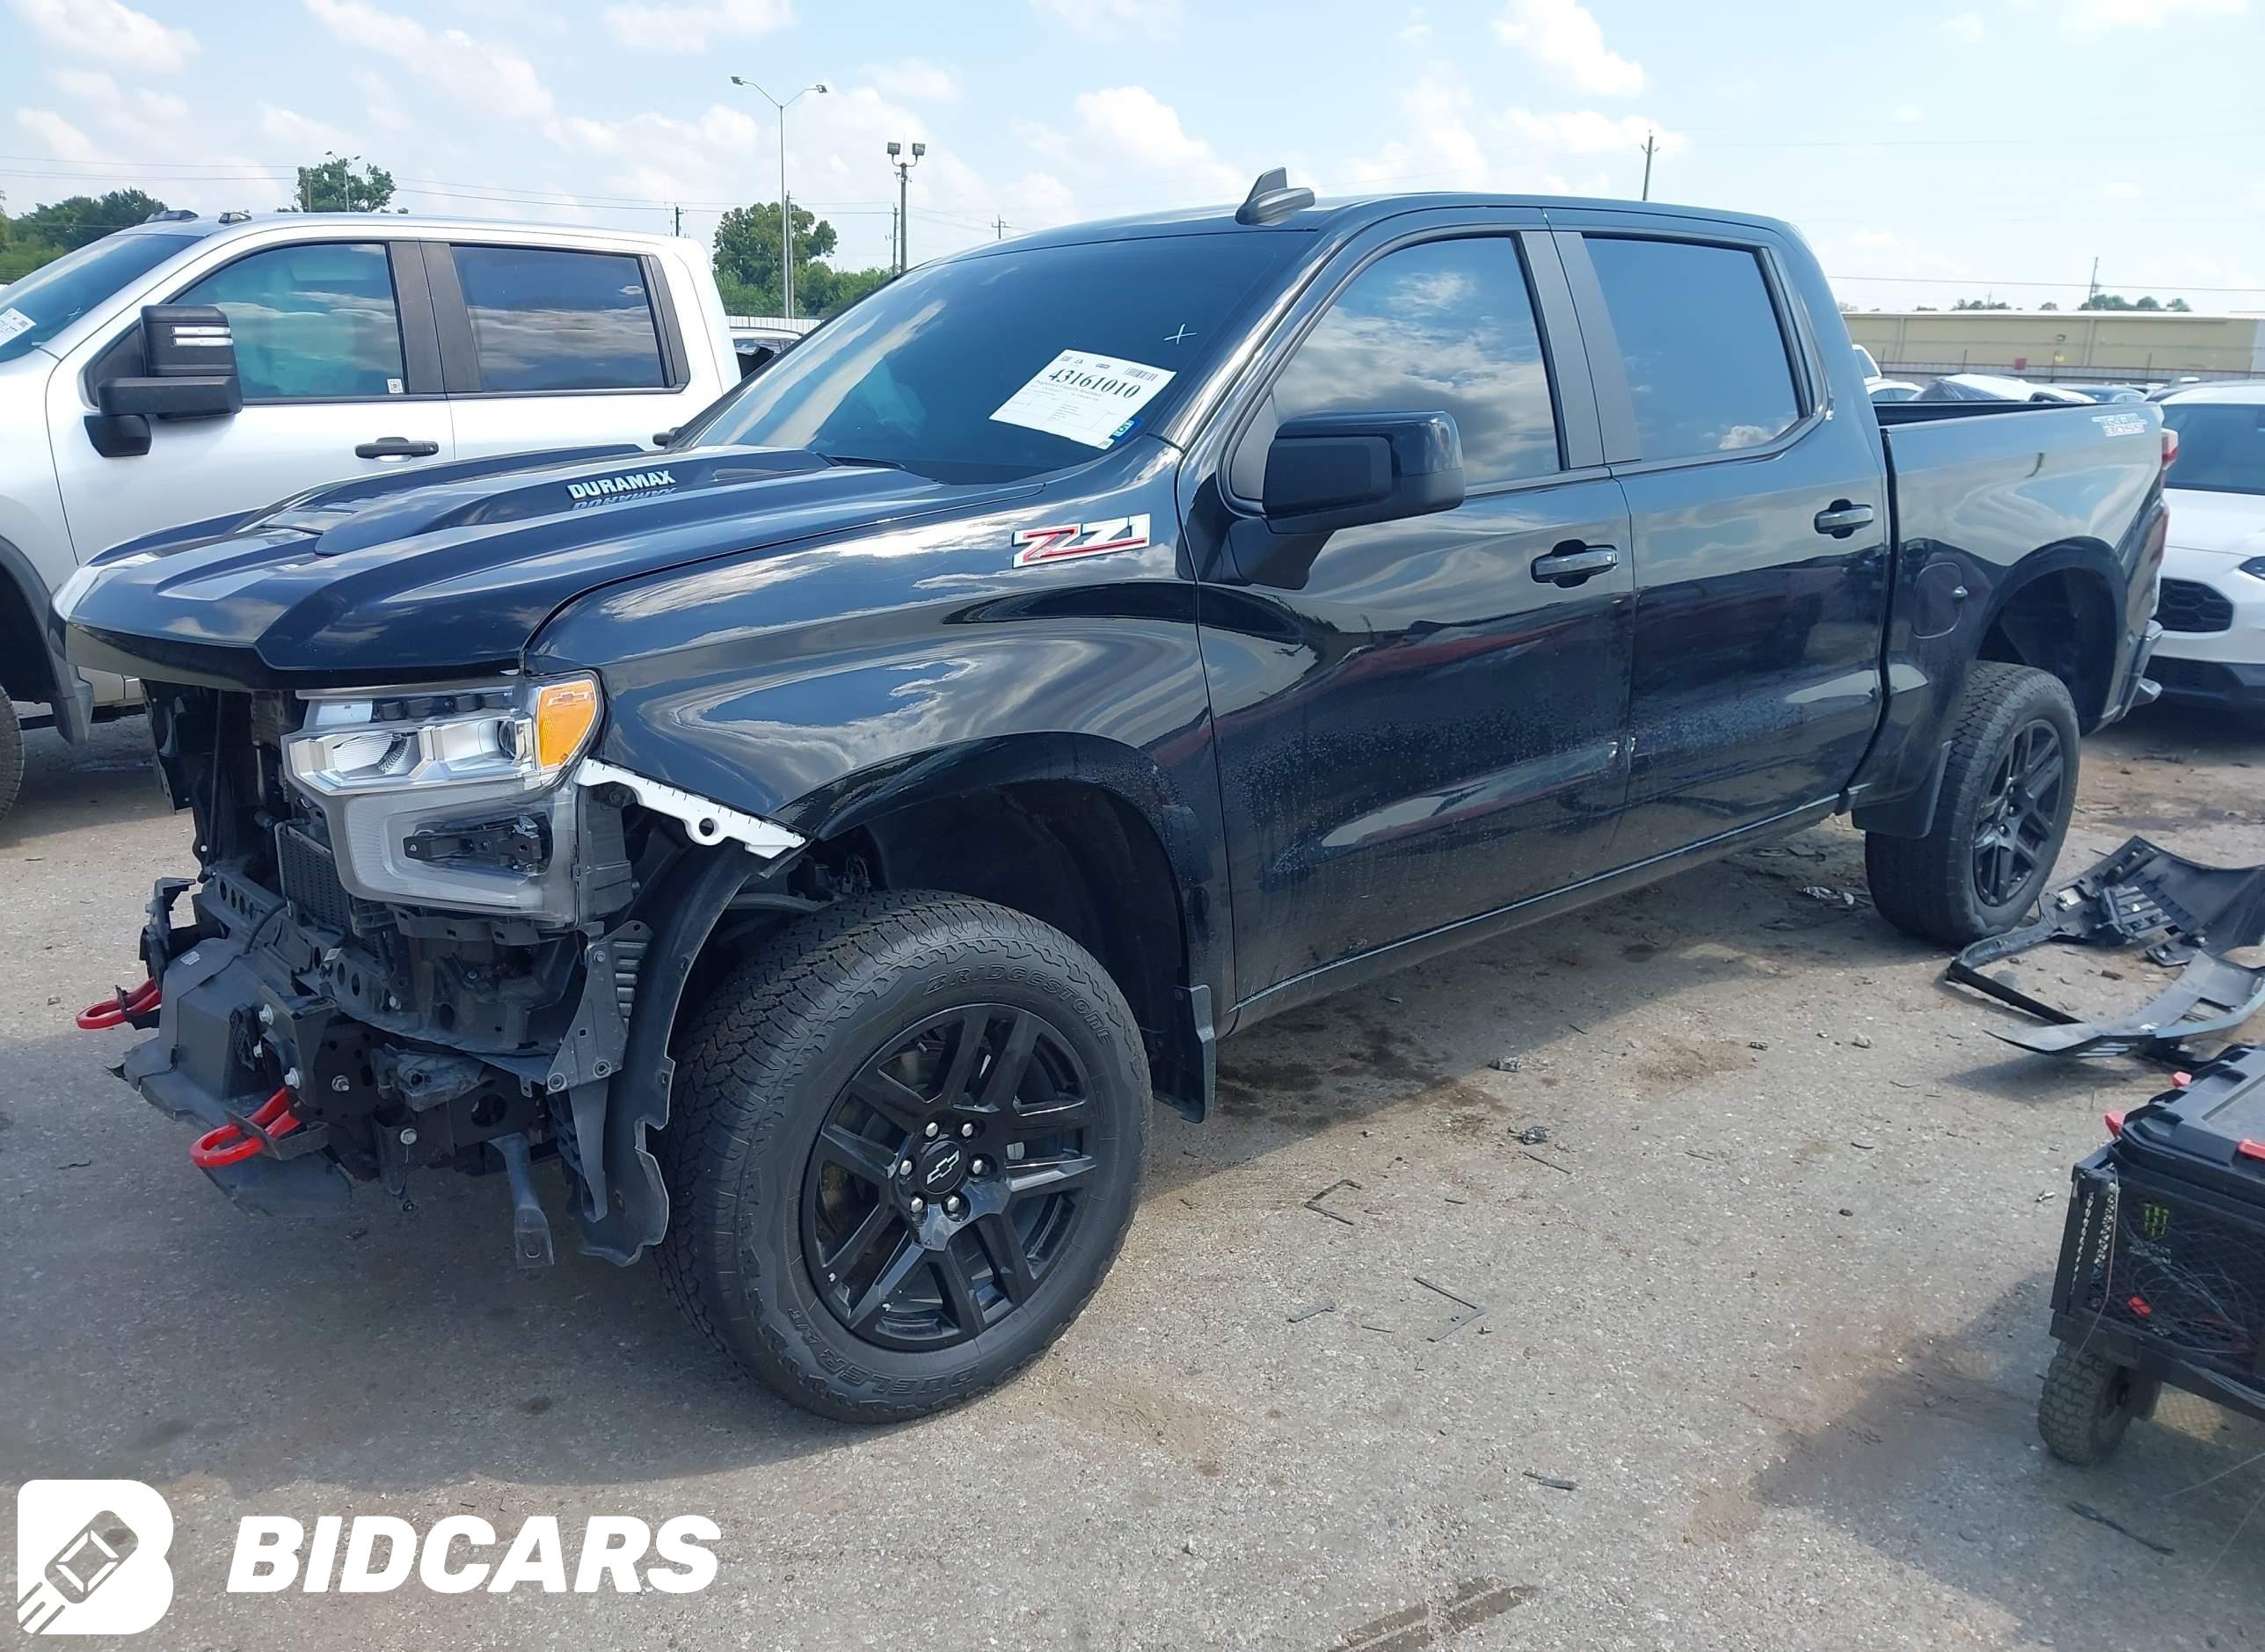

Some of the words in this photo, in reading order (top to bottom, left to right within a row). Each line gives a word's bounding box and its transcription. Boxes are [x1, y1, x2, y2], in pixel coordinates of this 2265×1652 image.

[1048, 368, 1141, 398] 43161010
[567, 469, 676, 500] DURAMAX
[1013, 513, 1151, 569] Z71
[922, 964, 1115, 1044] BRIDGESTONE
